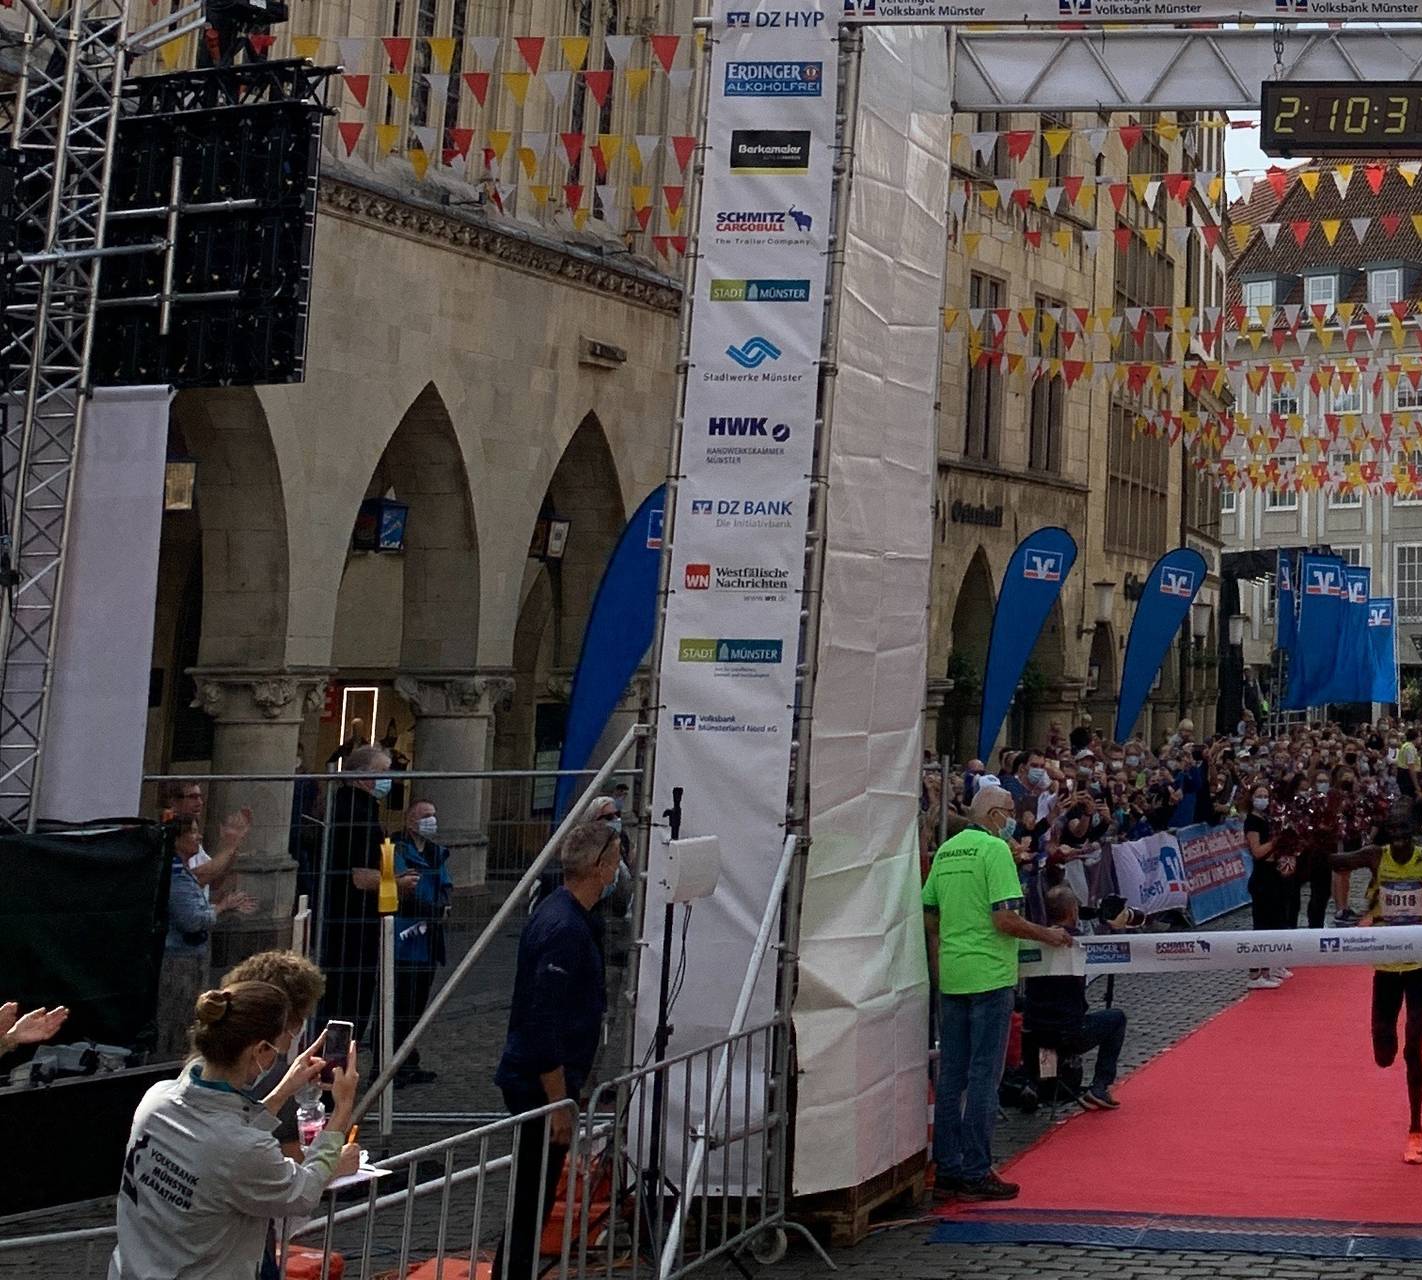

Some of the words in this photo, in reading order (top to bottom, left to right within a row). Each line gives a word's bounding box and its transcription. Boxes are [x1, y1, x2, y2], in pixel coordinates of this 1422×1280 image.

[879, 6, 935, 16] Volksbank
[938, 6, 985, 16] Münster
[1095, 5, 1151, 15] Volksbank
[1155, 4, 1202, 14] Münster
[1311, 3, 1368, 13] Volksbank
[1371, 3, 1418, 13] Münster
[756, 11, 781, 27] DZ
[785, 11, 825, 27] HYP
[727, 64, 802, 81] ERDINGER
[727, 82, 820, 91] ALKOHOLFREI
[716, 212, 786, 223] SCHMITZ
[716, 223, 785, 232] CARGOBULL
[714, 289, 744, 298] STADT
[760, 287, 806, 298] MÜNSTER
[703, 373, 759, 382] Stadtwerke
[762, 373, 803, 382] Münster
[708, 417, 768, 436] HWK
[717, 501, 740, 515] DZ
[743, 501, 793, 516] BANK
[715, 567, 789, 578] Westfälische
[686, 575, 709, 588] WN
[715, 578, 788, 589] Nachrichten
[683, 649, 713, 658] STADT
[730, 648, 778, 660] MÜNSTER
[699, 715, 736, 723] Volksbank
[1155, 941, 1195, 949] SCHMITZ
[150, 1148, 200, 1186] VOLKSBANK
[152, 1166, 194, 1197] MÜNSTER
[139, 1173, 192, 1210] MARATHON
